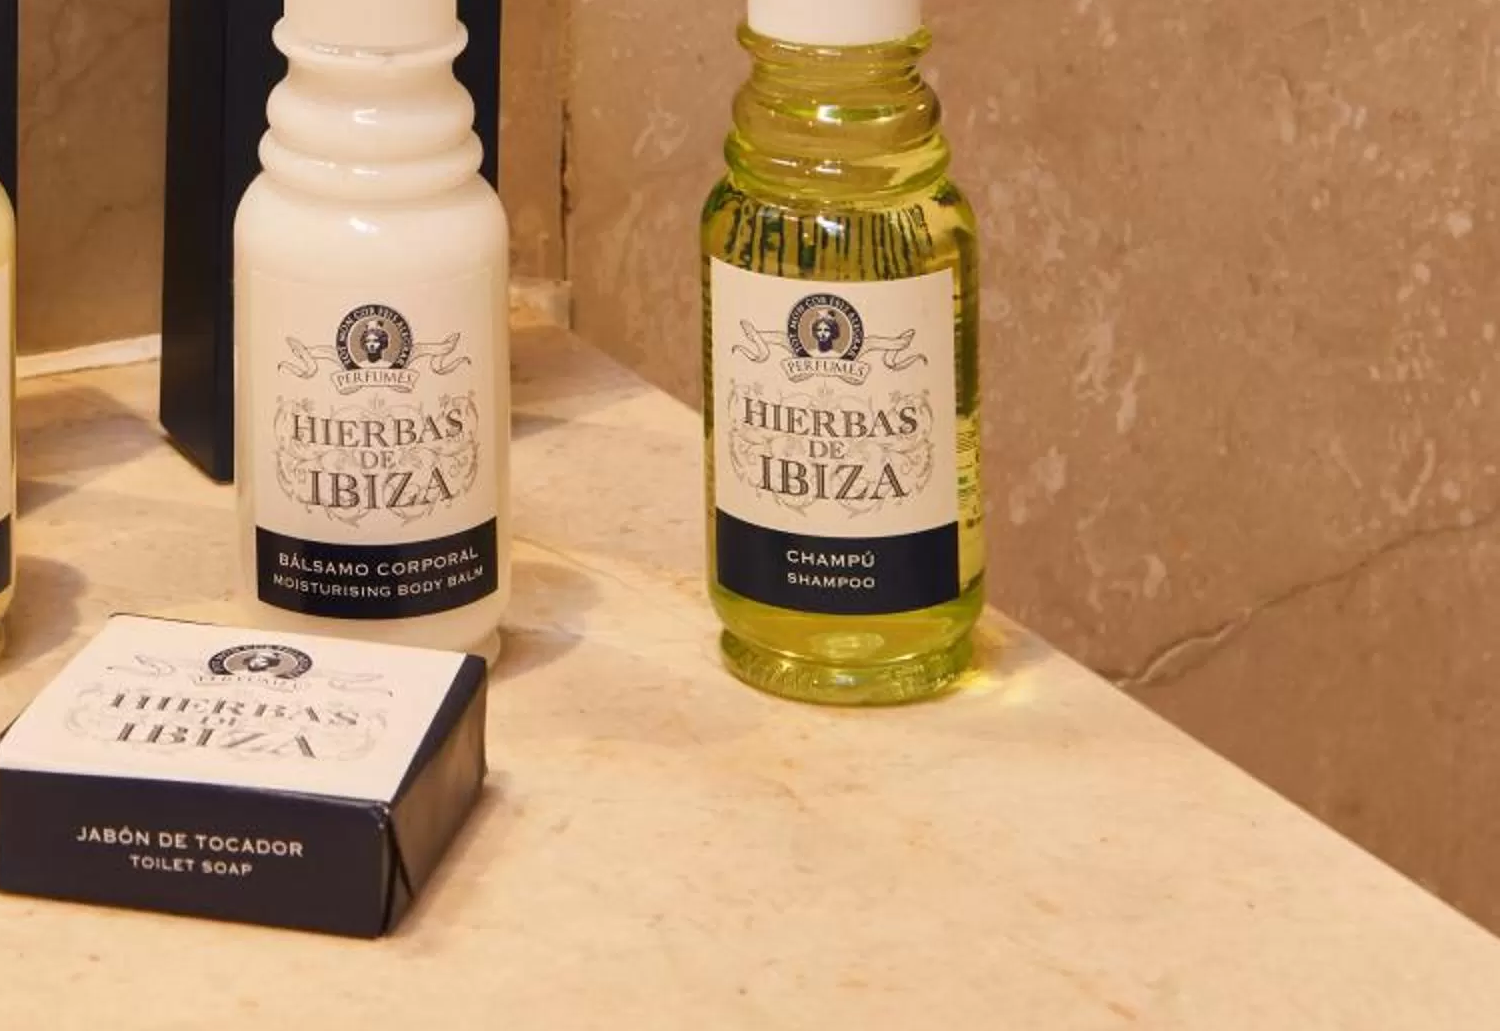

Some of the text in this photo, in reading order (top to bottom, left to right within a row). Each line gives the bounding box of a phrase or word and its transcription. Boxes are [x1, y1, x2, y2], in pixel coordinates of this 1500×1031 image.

[337, 371, 412, 386] PERFUMES
[787, 360, 865, 376] PERFUMES
[291, 408, 465, 448] HIERBAS
[743, 396, 918, 438] HIERBAS
[360, 450, 395, 470] DE
[808, 440, 846, 460] DE
[307, 466, 455, 510] IBIZA
[758, 455, 908, 500] IBIZA
[279, 546, 478, 577] BÁLSAMO CORPORAL
[786, 550, 875, 568] CHAMPÚ
[273, 565, 485, 598] MOISTURISING BODY BALM
[787, 573, 875, 589] SHAMPOO
[110, 693, 360, 725] HIERBAS
[116, 722, 317, 759] IBIZA
[76, 825, 304, 858] JABÓN DE TOCADOR
[129, 854, 252, 877] TOILET SOAP
